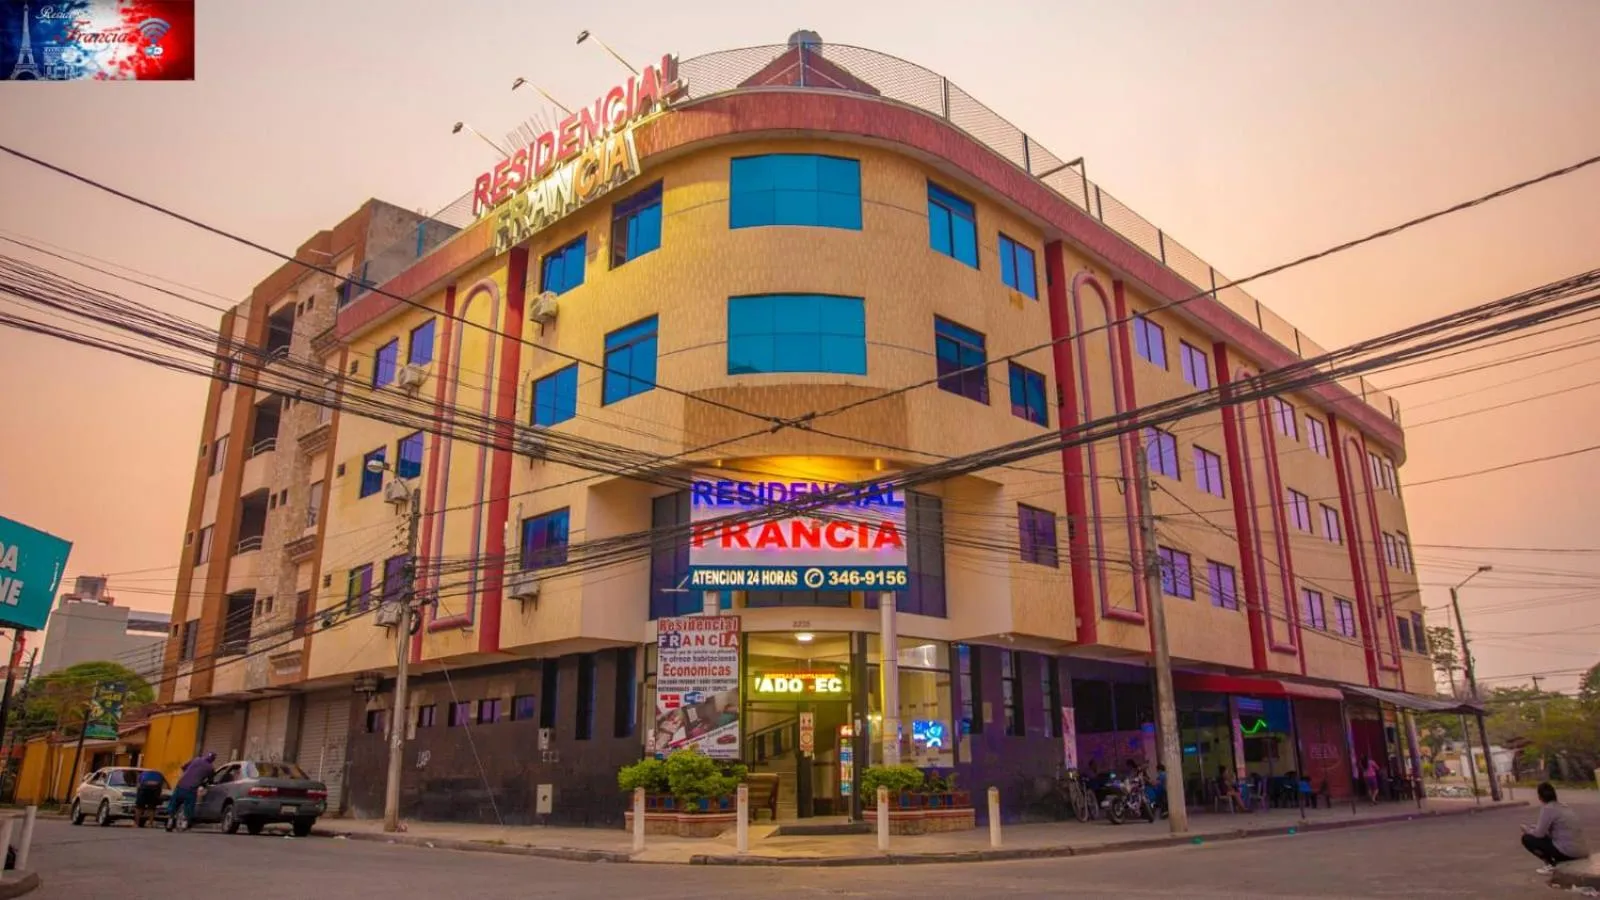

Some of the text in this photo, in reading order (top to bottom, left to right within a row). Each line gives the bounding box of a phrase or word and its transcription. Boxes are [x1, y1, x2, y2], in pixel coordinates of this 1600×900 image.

[472, 53, 685, 218] RESIDENCIAL
[493, 129, 638, 251] FRANCIA
[692, 519, 904, 549] FRANCIA
[692, 570, 907, 586] ATENCION 24 HORAS 346-9156
[659, 617, 739, 632] Residencial
[658, 633, 739, 648] FRANCIA
[669, 655, 692, 664] ofrece
